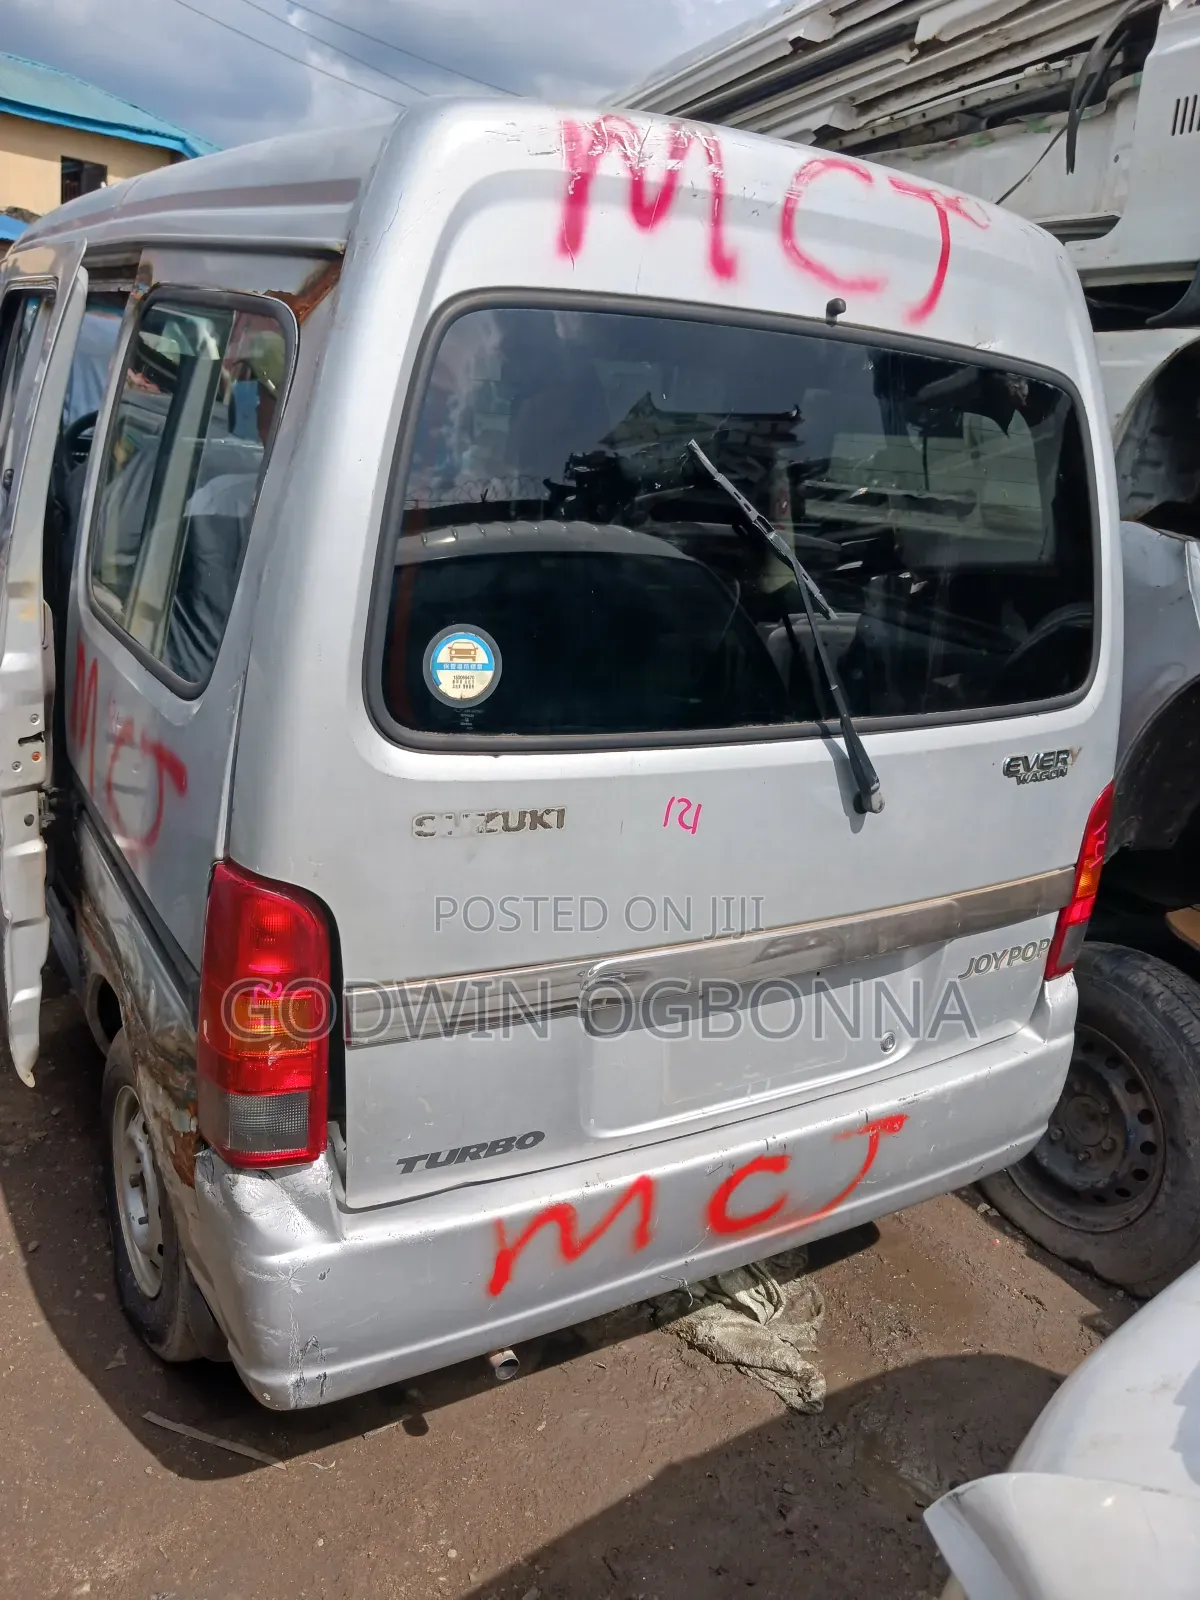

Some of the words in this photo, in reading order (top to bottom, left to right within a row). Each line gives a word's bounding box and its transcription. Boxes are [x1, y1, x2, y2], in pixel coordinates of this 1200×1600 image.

[1002, 746, 1082, 778] EVERY
[1015, 765, 1068, 786] WAGON
[411, 806, 567, 838] SZUKI
[957, 937, 1052, 980] JOYPOP
[396, 1130, 546, 1175] TURBO
